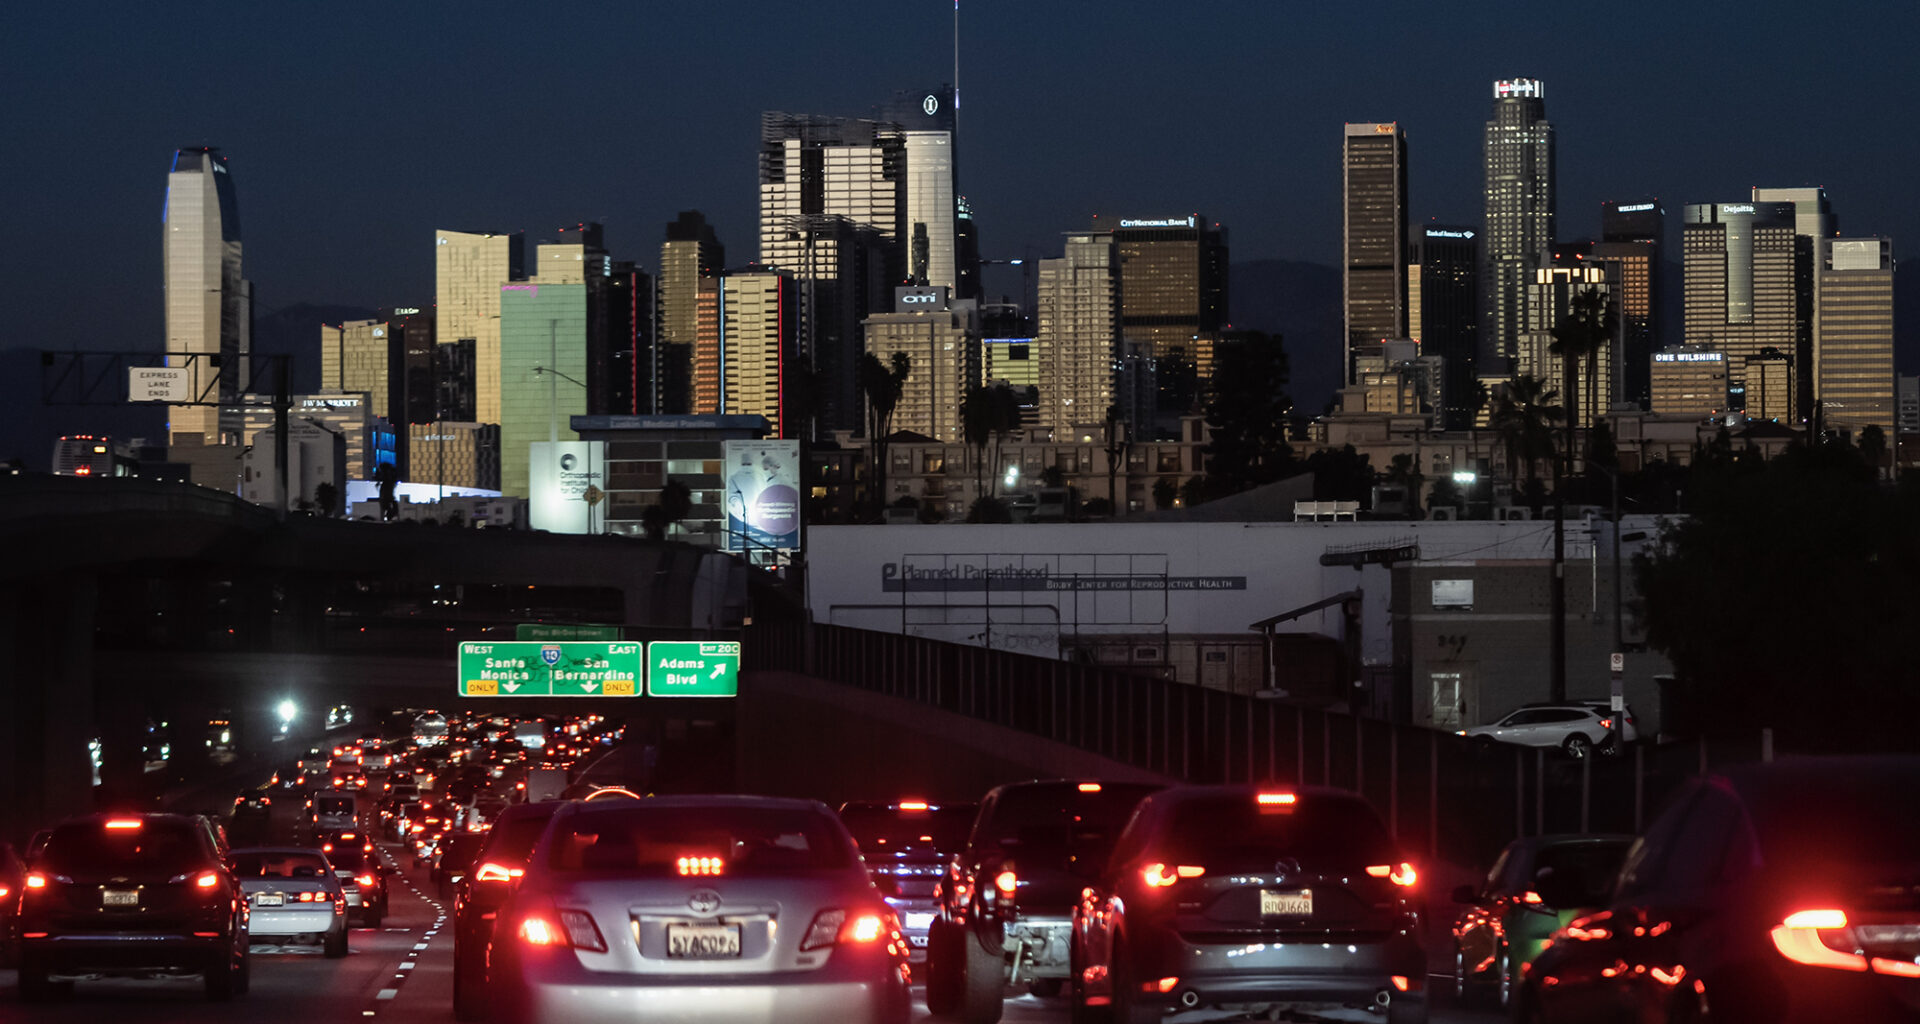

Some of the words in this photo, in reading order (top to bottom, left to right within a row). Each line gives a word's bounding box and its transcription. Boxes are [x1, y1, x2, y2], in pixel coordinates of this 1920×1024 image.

[1655, 353, 1675, 361] ONE
[1677, 353, 1722, 361] WILSHIRE
[904, 563, 959, 580] Planned
[964, 563, 1049, 580] Parenthood
[1199, 578, 1232, 588] HEALTH
[464, 645, 493, 654] WEST
[608, 645, 637, 654] EAST
[718, 645, 739, 653] 20C
[544, 651, 558, 660] 10
[485, 658, 525, 668] Santa
[583, 658, 609, 668] San
[659, 658, 705, 669] Adams
[480, 670, 529, 680] Monica
[554, 670, 635, 680] Bernardino
[666, 673, 697, 685] Blvd
[469, 684, 496, 692] ONLY
[605, 684, 632, 692] ONLY
